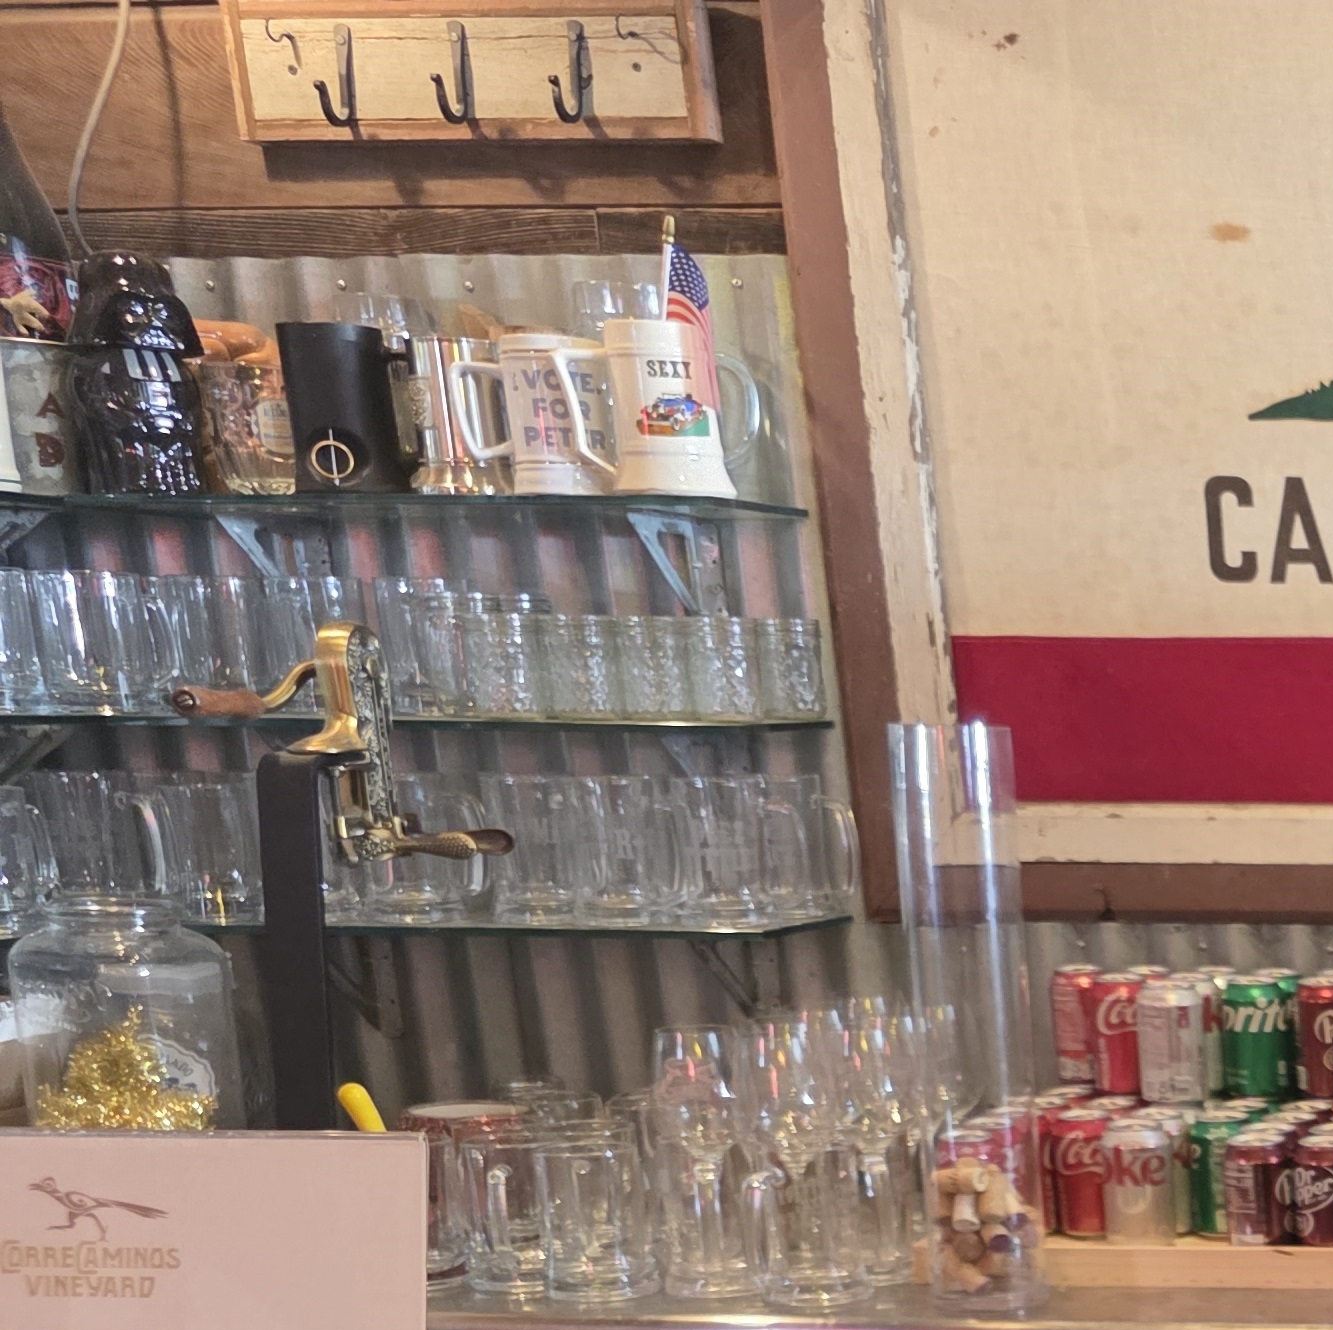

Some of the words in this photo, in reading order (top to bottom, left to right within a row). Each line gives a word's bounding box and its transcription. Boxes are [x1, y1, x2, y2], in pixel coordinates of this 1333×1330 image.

[646, 360, 692, 380] SEXY
[524, 427, 606, 450] PETR
[24, 1275, 156, 1298] VINEYARD
